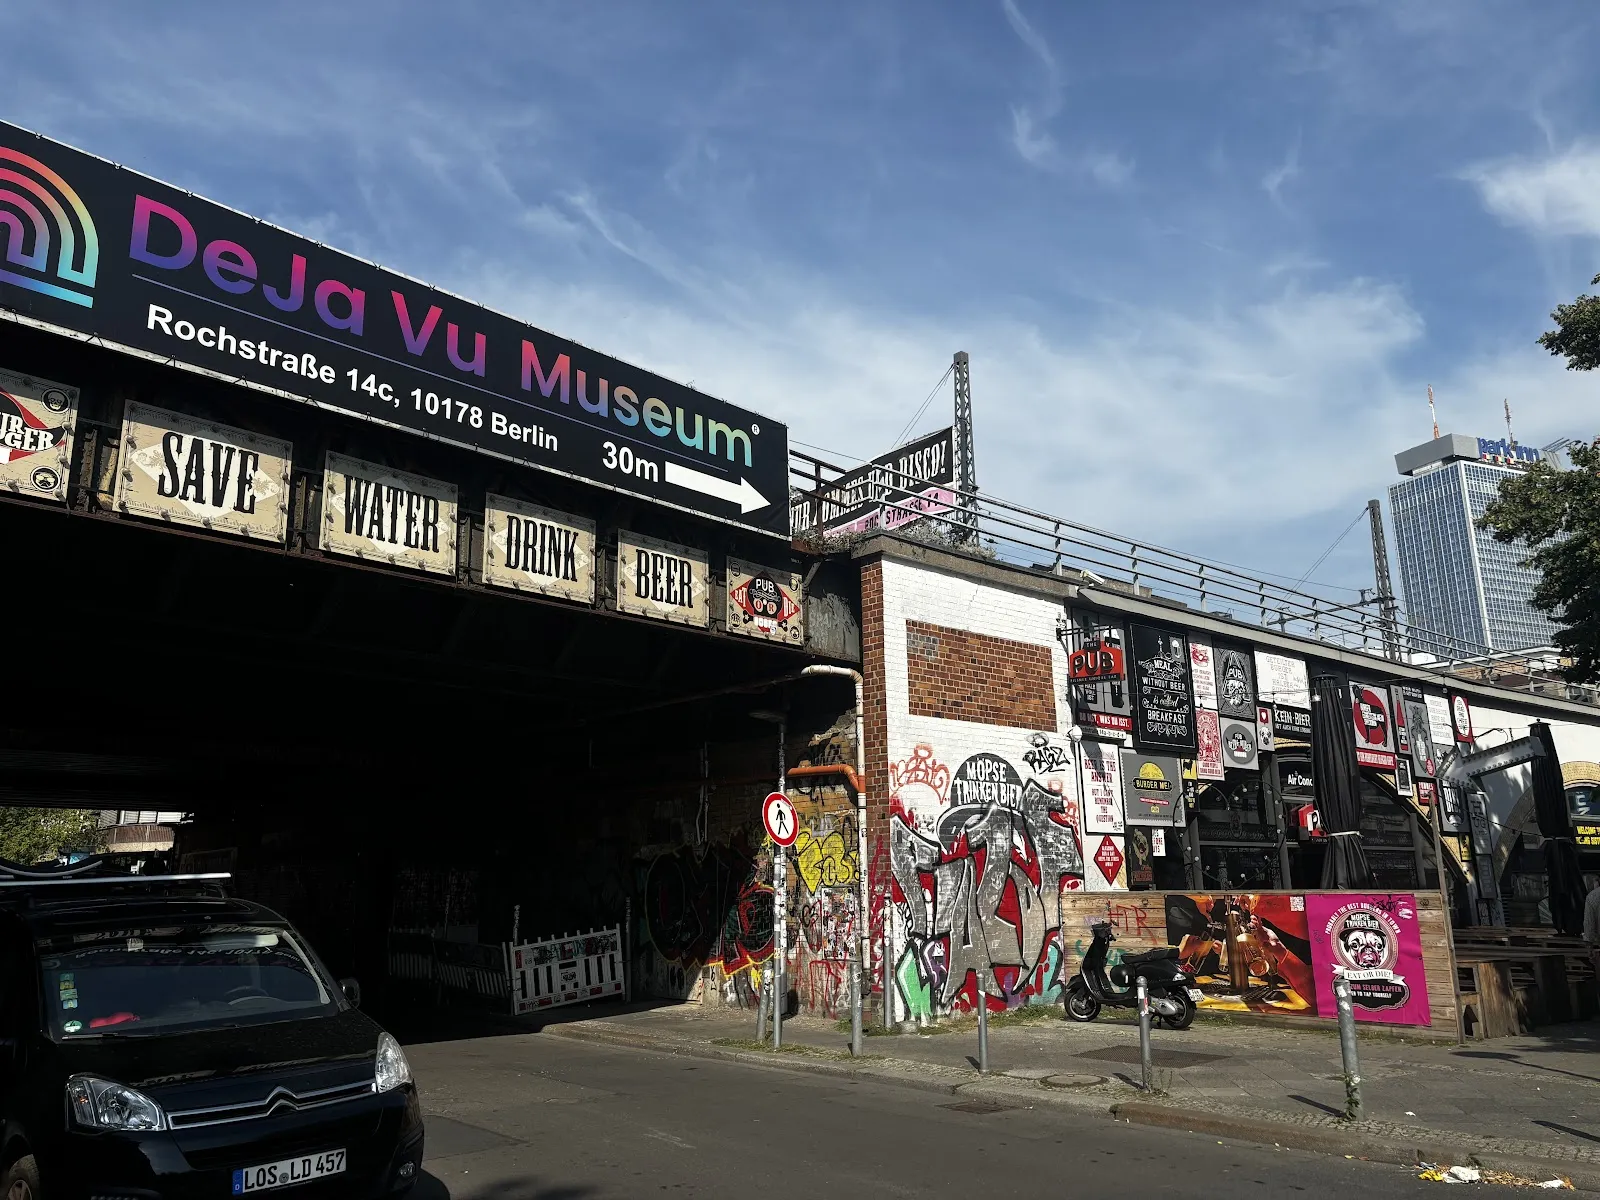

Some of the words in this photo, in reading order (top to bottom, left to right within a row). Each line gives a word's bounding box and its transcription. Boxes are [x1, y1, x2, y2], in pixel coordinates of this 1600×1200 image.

[129, 193, 366, 337] DeJa
[390, 290, 487, 378] Vu
[146, 303, 336, 385] Rochstraße
[346, 368, 401, 408] 14c,
[410, 388, 484, 429] 10178
[491, 412, 559, 452] Berlin
[602, 441, 660, 483] 30m
[1477, 436, 1512, 458] park
[1513, 440, 1540, 463] inn
[157, 431, 259, 515] SAVE
[898, 439, 948, 490] DISCO!
[343, 473, 440, 553] WATER
[504, 514, 579, 583] DRINK
[635, 548, 694, 608] BEER
[755, 578, 775, 593] PUB
[1073, 650, 1115, 676] PUB
[1153, 659, 1173, 672] MEAL
[1228, 667, 1243, 680] PUB
[1142, 676, 1168, 690] WITHOUT
[1169, 680, 1186, 692] BEER
[1099, 715, 1111, 725] WAS
[1147, 709, 1186, 725] BREAKFAST
[966, 756, 1007, 783] MÖPSE
[1091, 771, 1113, 784] ANSWER
[1106, 762, 1117, 772] THE
[1287, 773, 1297, 785] Air
[954, 777, 1000, 805] TRINKEN
[1135, 779, 1158, 790] BURGER
[1159, 781, 1170, 790] ME!
[1096, 814, 1114, 824] QUESTION
[1324, 912, 1340, 935] PROBABLY
[1338, 906, 1348, 914] THE
[1347, 902, 1360, 911] BEST
[1382, 911, 1388, 919] IN
[1387, 915, 1402, 935] TOWN
[1347, 971, 1361, 979] EAT
[1375, 970, 1391, 978] DIE!
[1381, 985, 1402, 993] ZAPFEN
[244, 1166, 277, 1191] LOS
[290, 1157, 312, 1181] LD
[315, 1150, 345, 1175] 457
